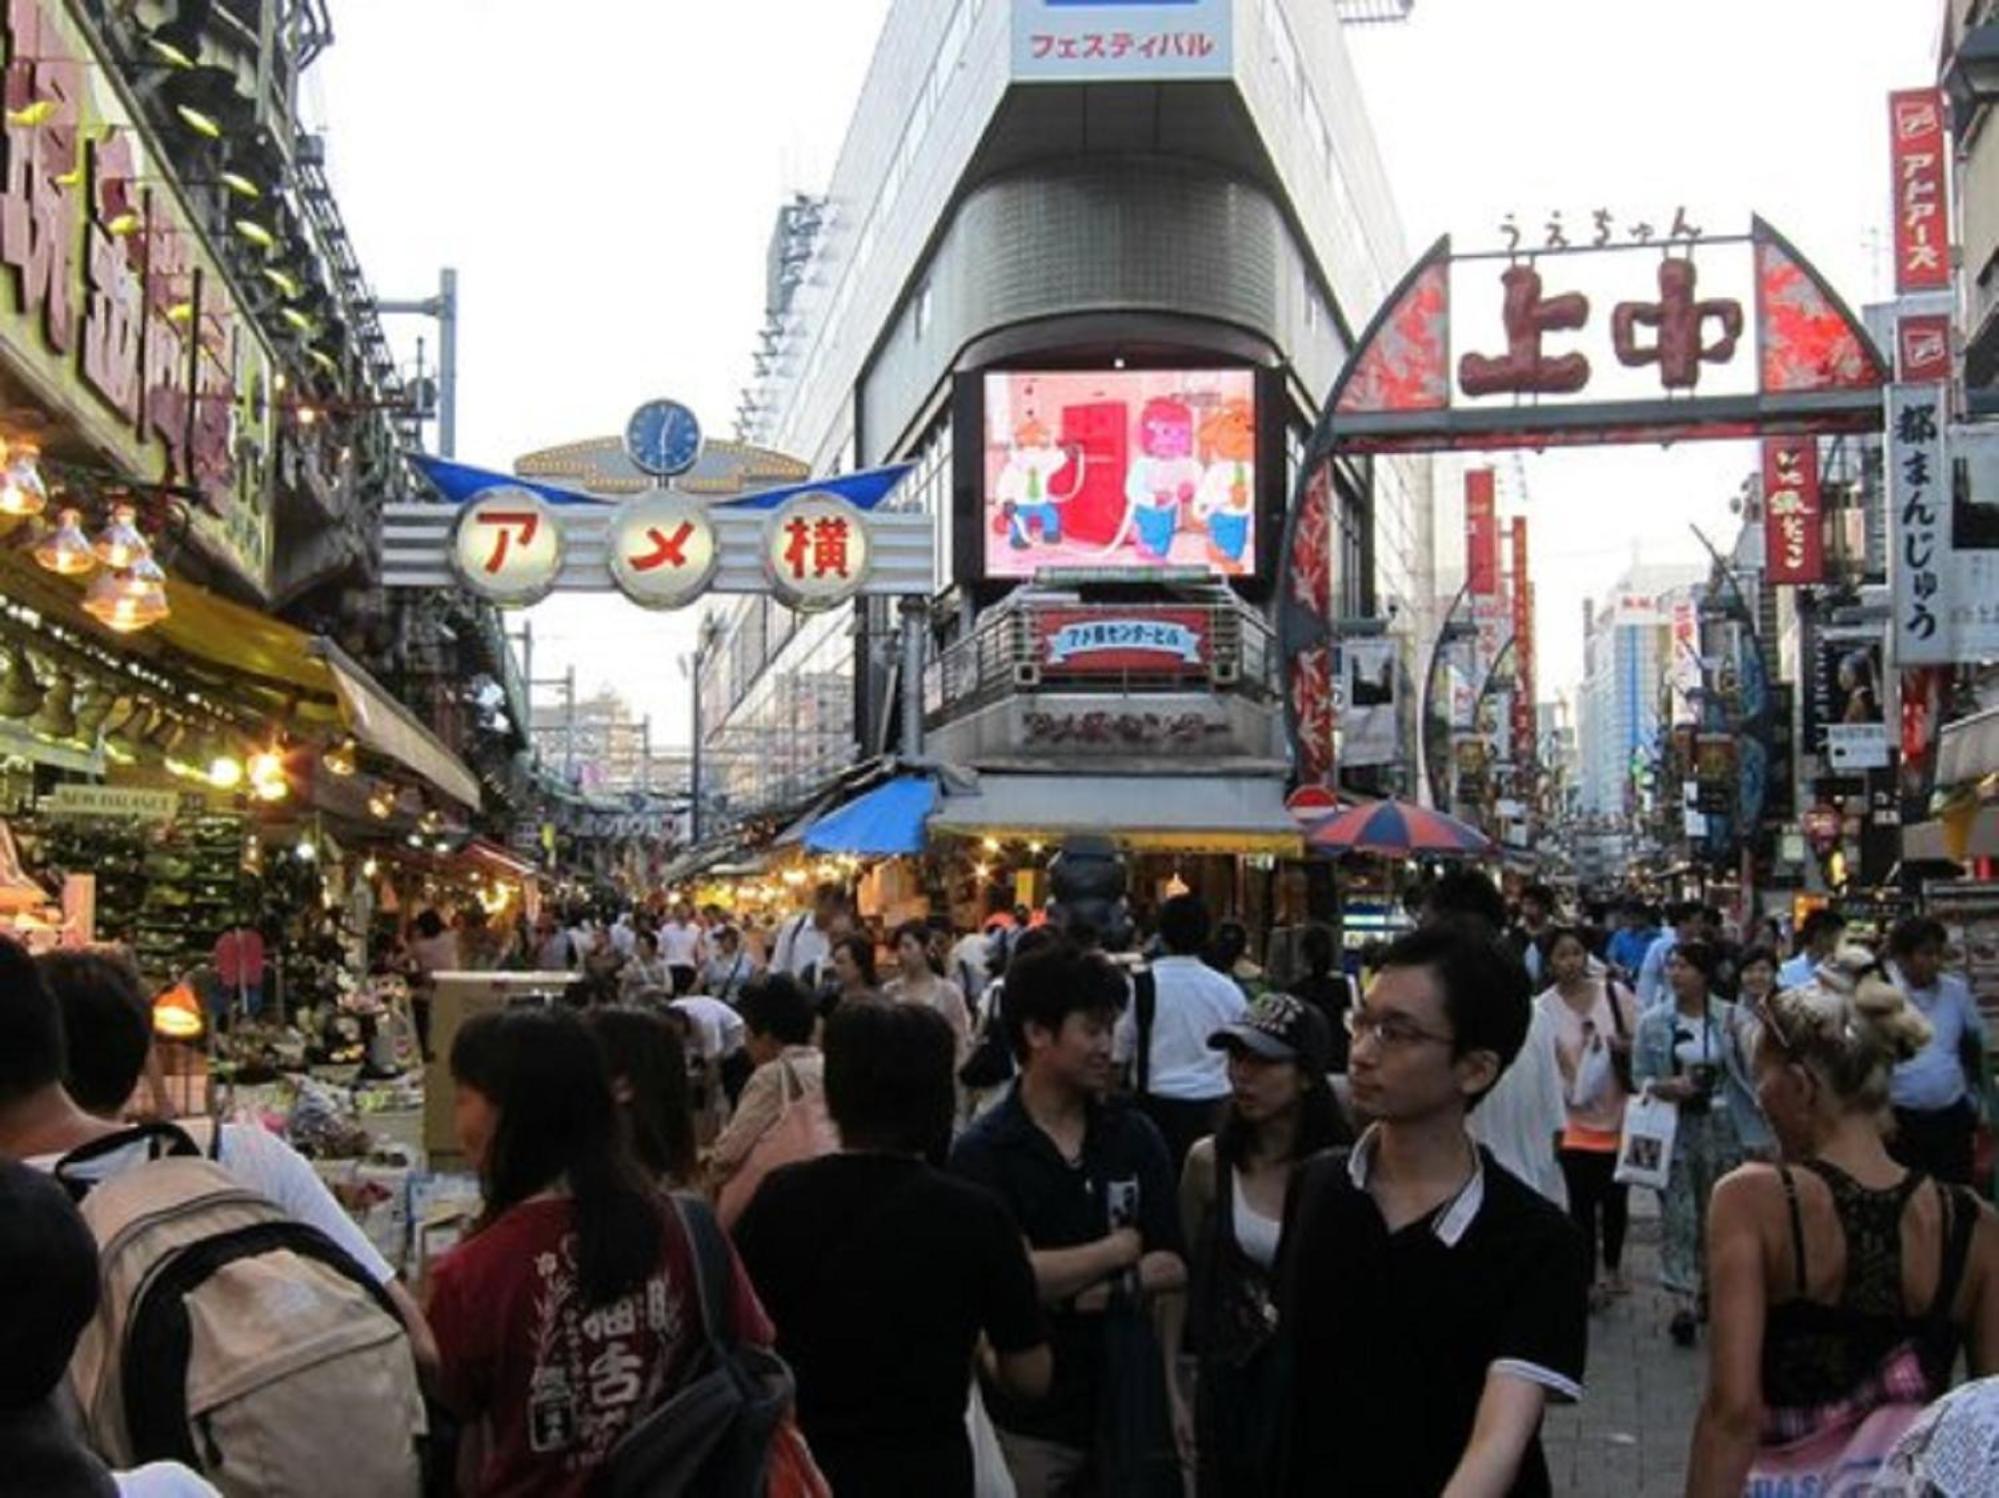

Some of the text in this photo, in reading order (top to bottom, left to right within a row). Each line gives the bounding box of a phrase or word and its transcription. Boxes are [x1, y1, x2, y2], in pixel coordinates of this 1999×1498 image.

[1030, 32, 1214, 59] フェスティバル
[1500, 206, 1702, 250] うえちゃん
[1458, 257, 1743, 396] 上中
[476, 513, 849, 579] アメ横
[1897, 404, 1937, 640] 都まんじゅう
